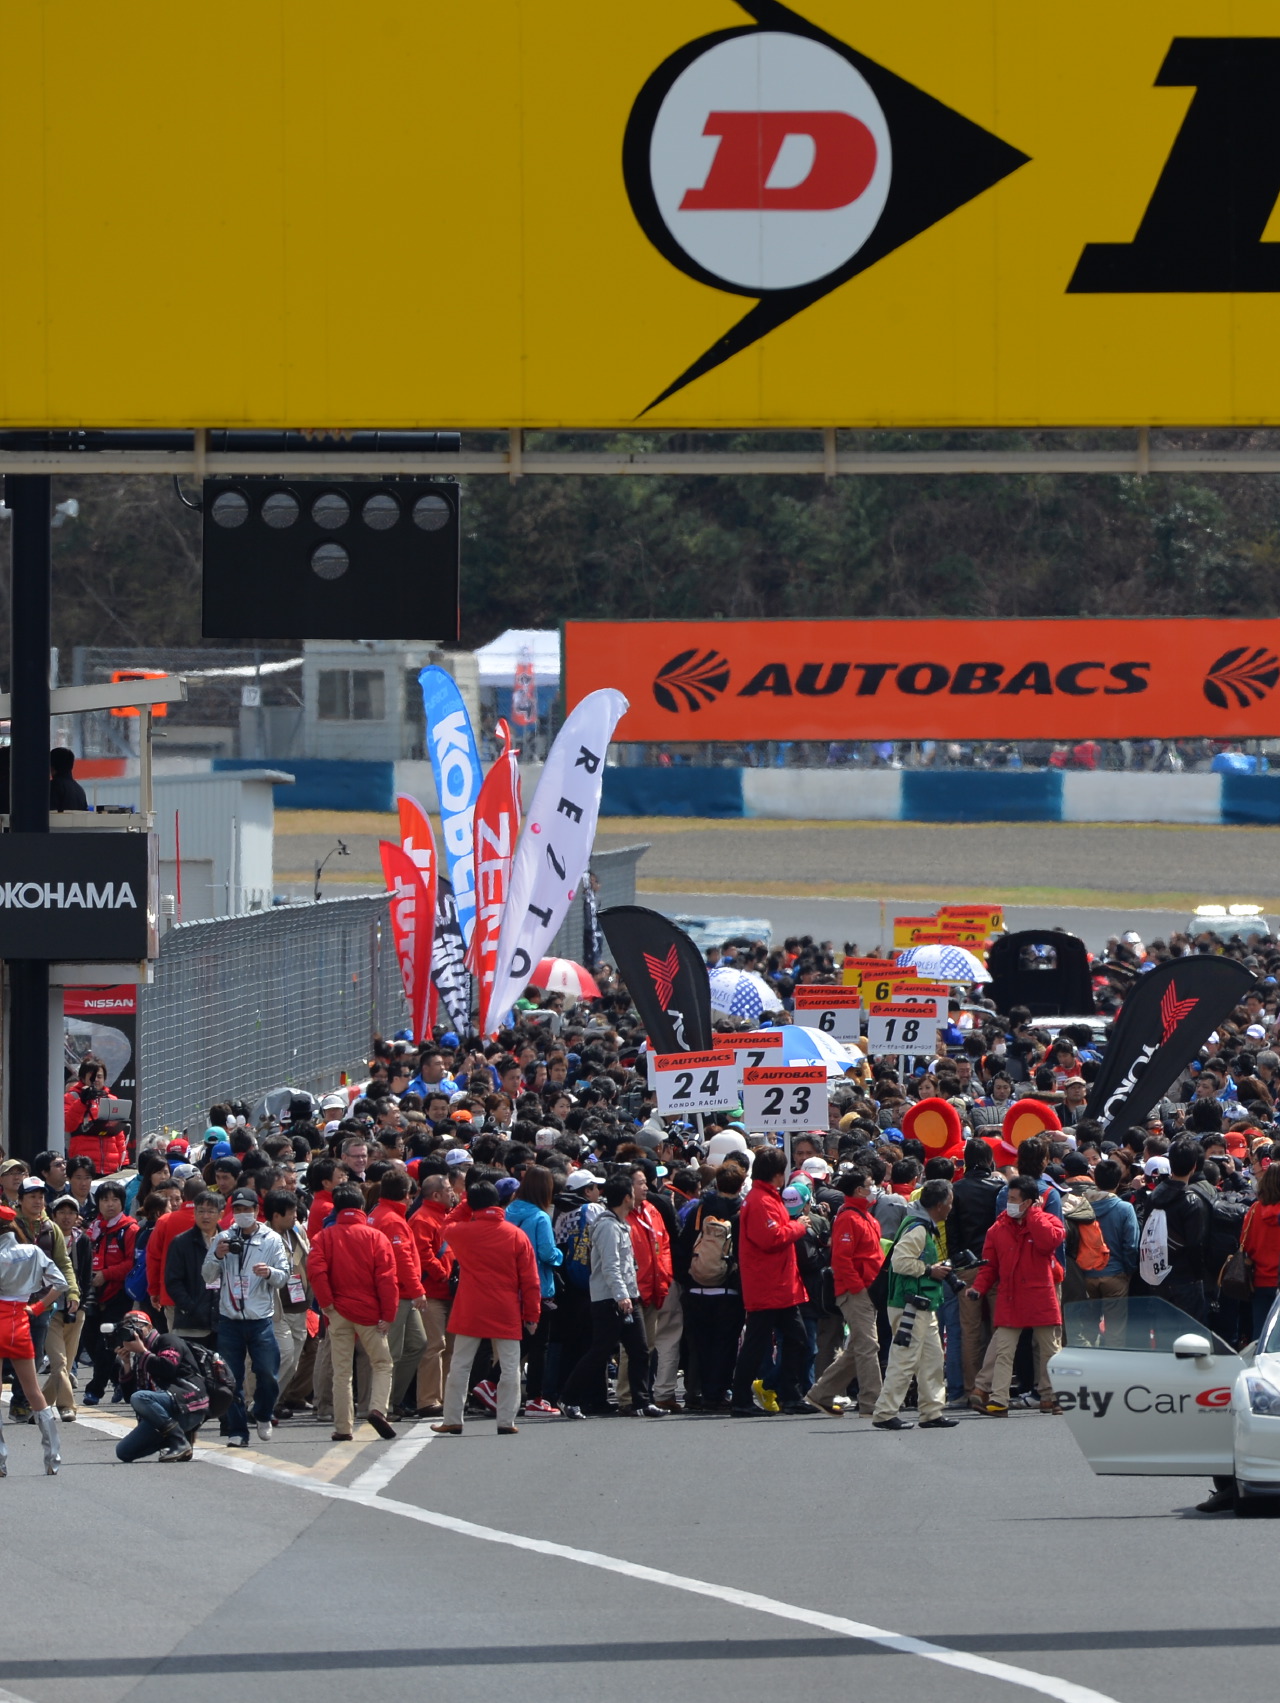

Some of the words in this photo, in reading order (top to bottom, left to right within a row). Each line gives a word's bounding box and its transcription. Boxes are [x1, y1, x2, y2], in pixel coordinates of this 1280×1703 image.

[737, 661, 1151, 698] AUTOBACS
[0, 882, 137, 908] KOHAMA
[873, 969, 916, 978] AUTOBACS
[807, 988, 855, 996] AUTOBACS
[904, 985, 947, 993] AUTOBACS
[84, 999, 134, 1008] NISSAN
[805, 998, 857, 1006] AUTOBACS
[883, 1006, 934, 1014] AUTOBACS
[818, 1010, 837, 1033] 6
[885, 1018, 920, 1042] 18
[723, 1036, 781, 1045] AUTOBACS
[670, 1054, 732, 1066] AUTOBACS
[760, 1071, 824, 1080] AUTOBACS
[672, 1069, 720, 1100] 24
[668, 1101, 696, 1109] KONDO
[698, 1098, 729, 1107] RACING
[761, 1086, 811, 1116] 23
[1123, 1385, 1191, 1414] Car
